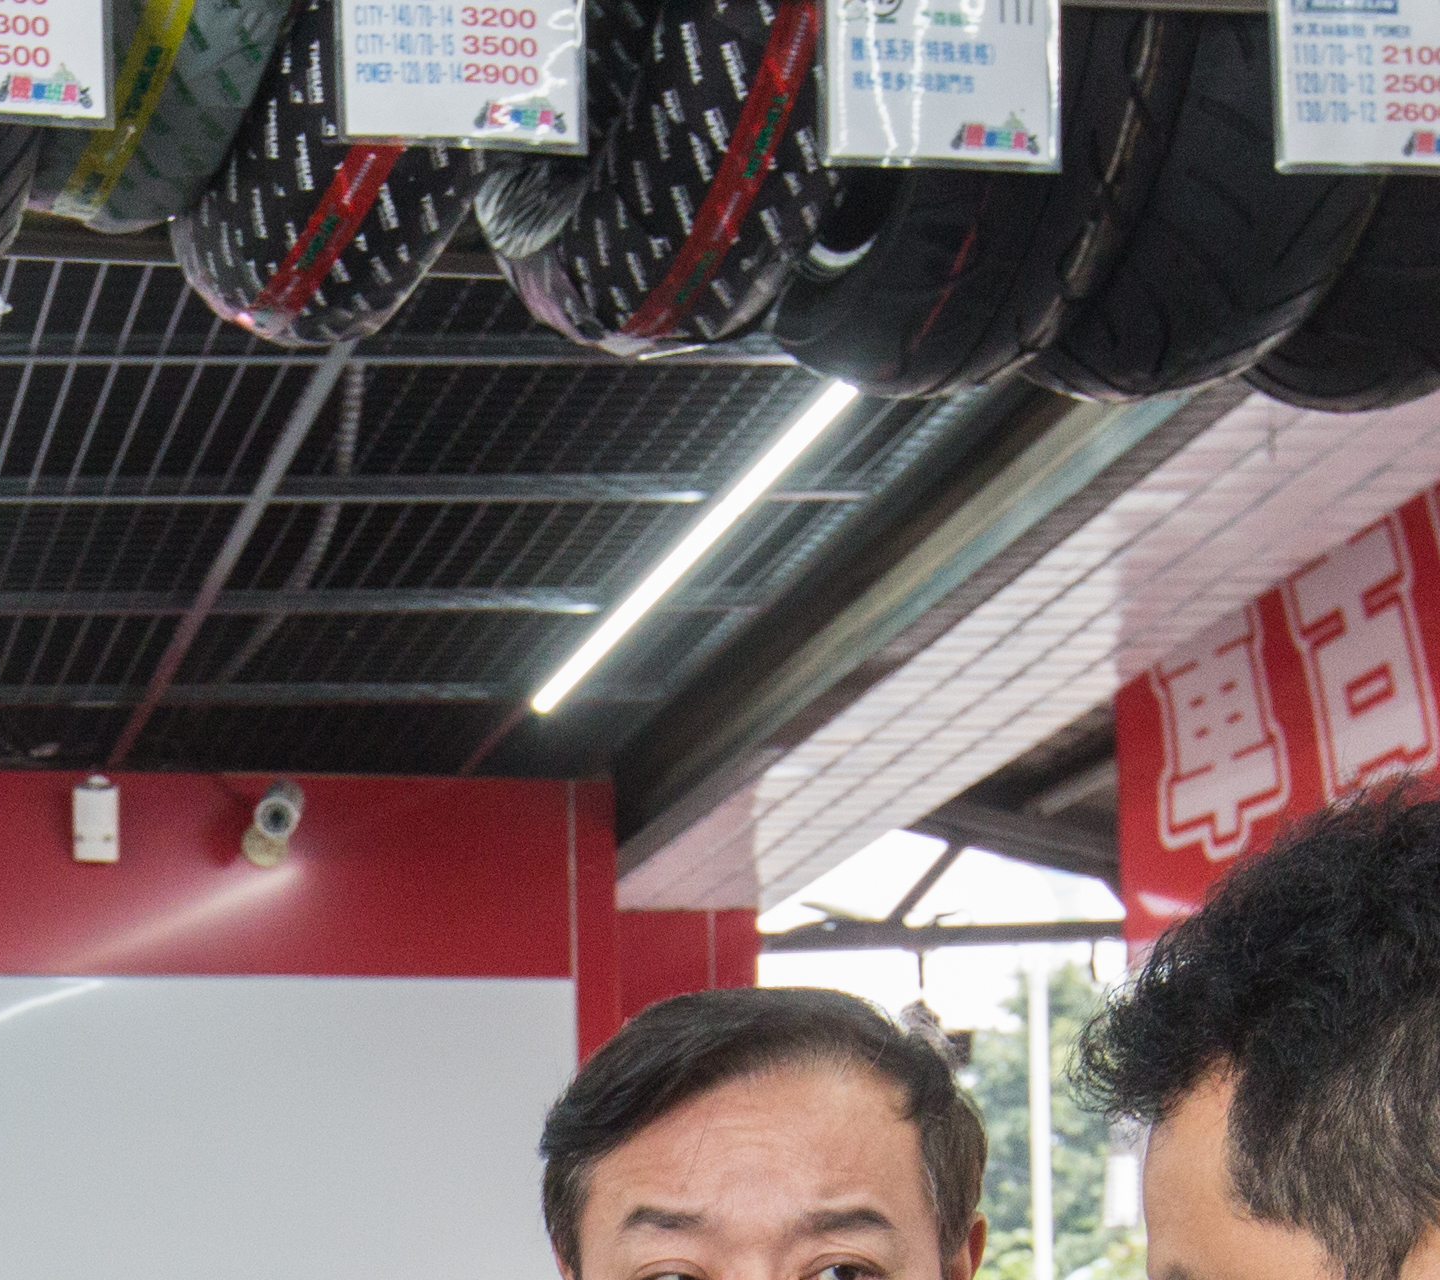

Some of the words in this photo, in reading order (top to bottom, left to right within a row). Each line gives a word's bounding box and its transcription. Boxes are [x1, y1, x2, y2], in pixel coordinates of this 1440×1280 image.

[461, 7, 536, 29] 3200
[462, 35, 538, 57] 3500
[1293, 43, 1374, 66] 110/70-12
[463, 63, 539, 86] 2900
[1295, 72, 1375, 95] 120/70-12
[1297, 100, 1377, 124] 130/70-12
